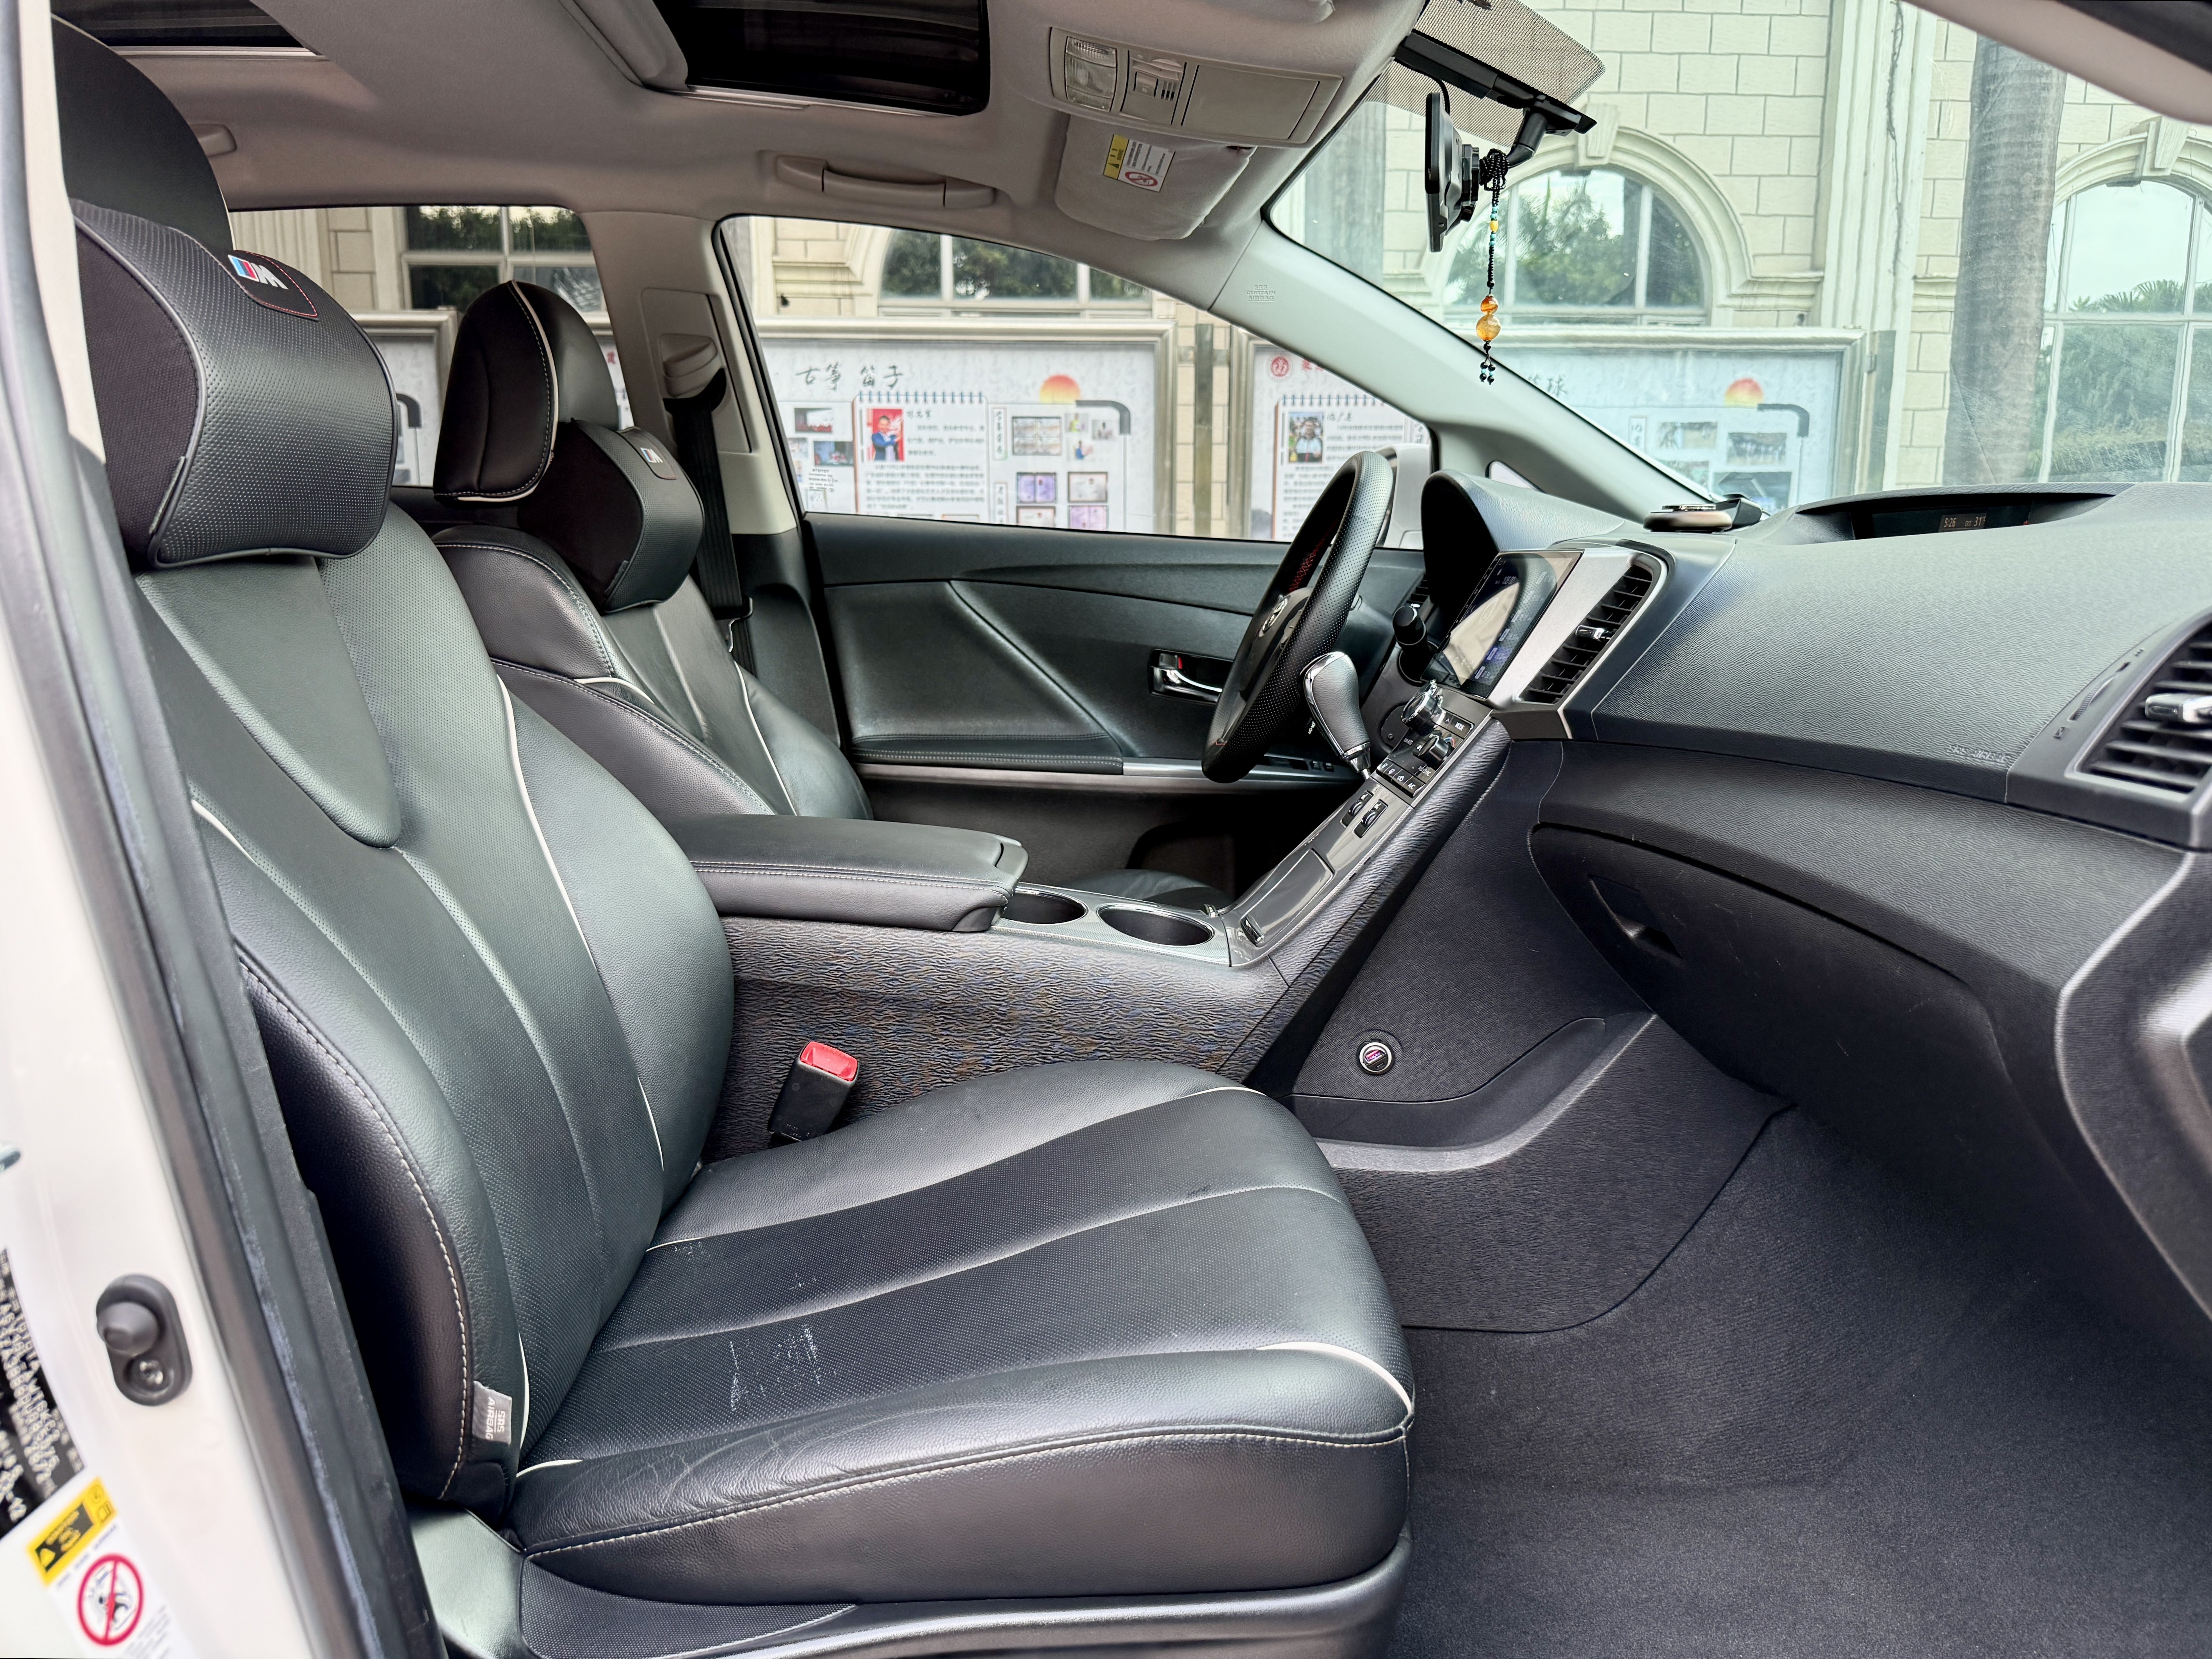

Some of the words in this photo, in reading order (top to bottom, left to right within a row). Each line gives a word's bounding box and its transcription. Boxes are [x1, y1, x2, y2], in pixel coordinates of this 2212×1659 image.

[1943, 517, 1957, 527] 5:26
[486, 1397, 495, 1440] AIRBAG
[497, 1410, 506, 1433] SRS
